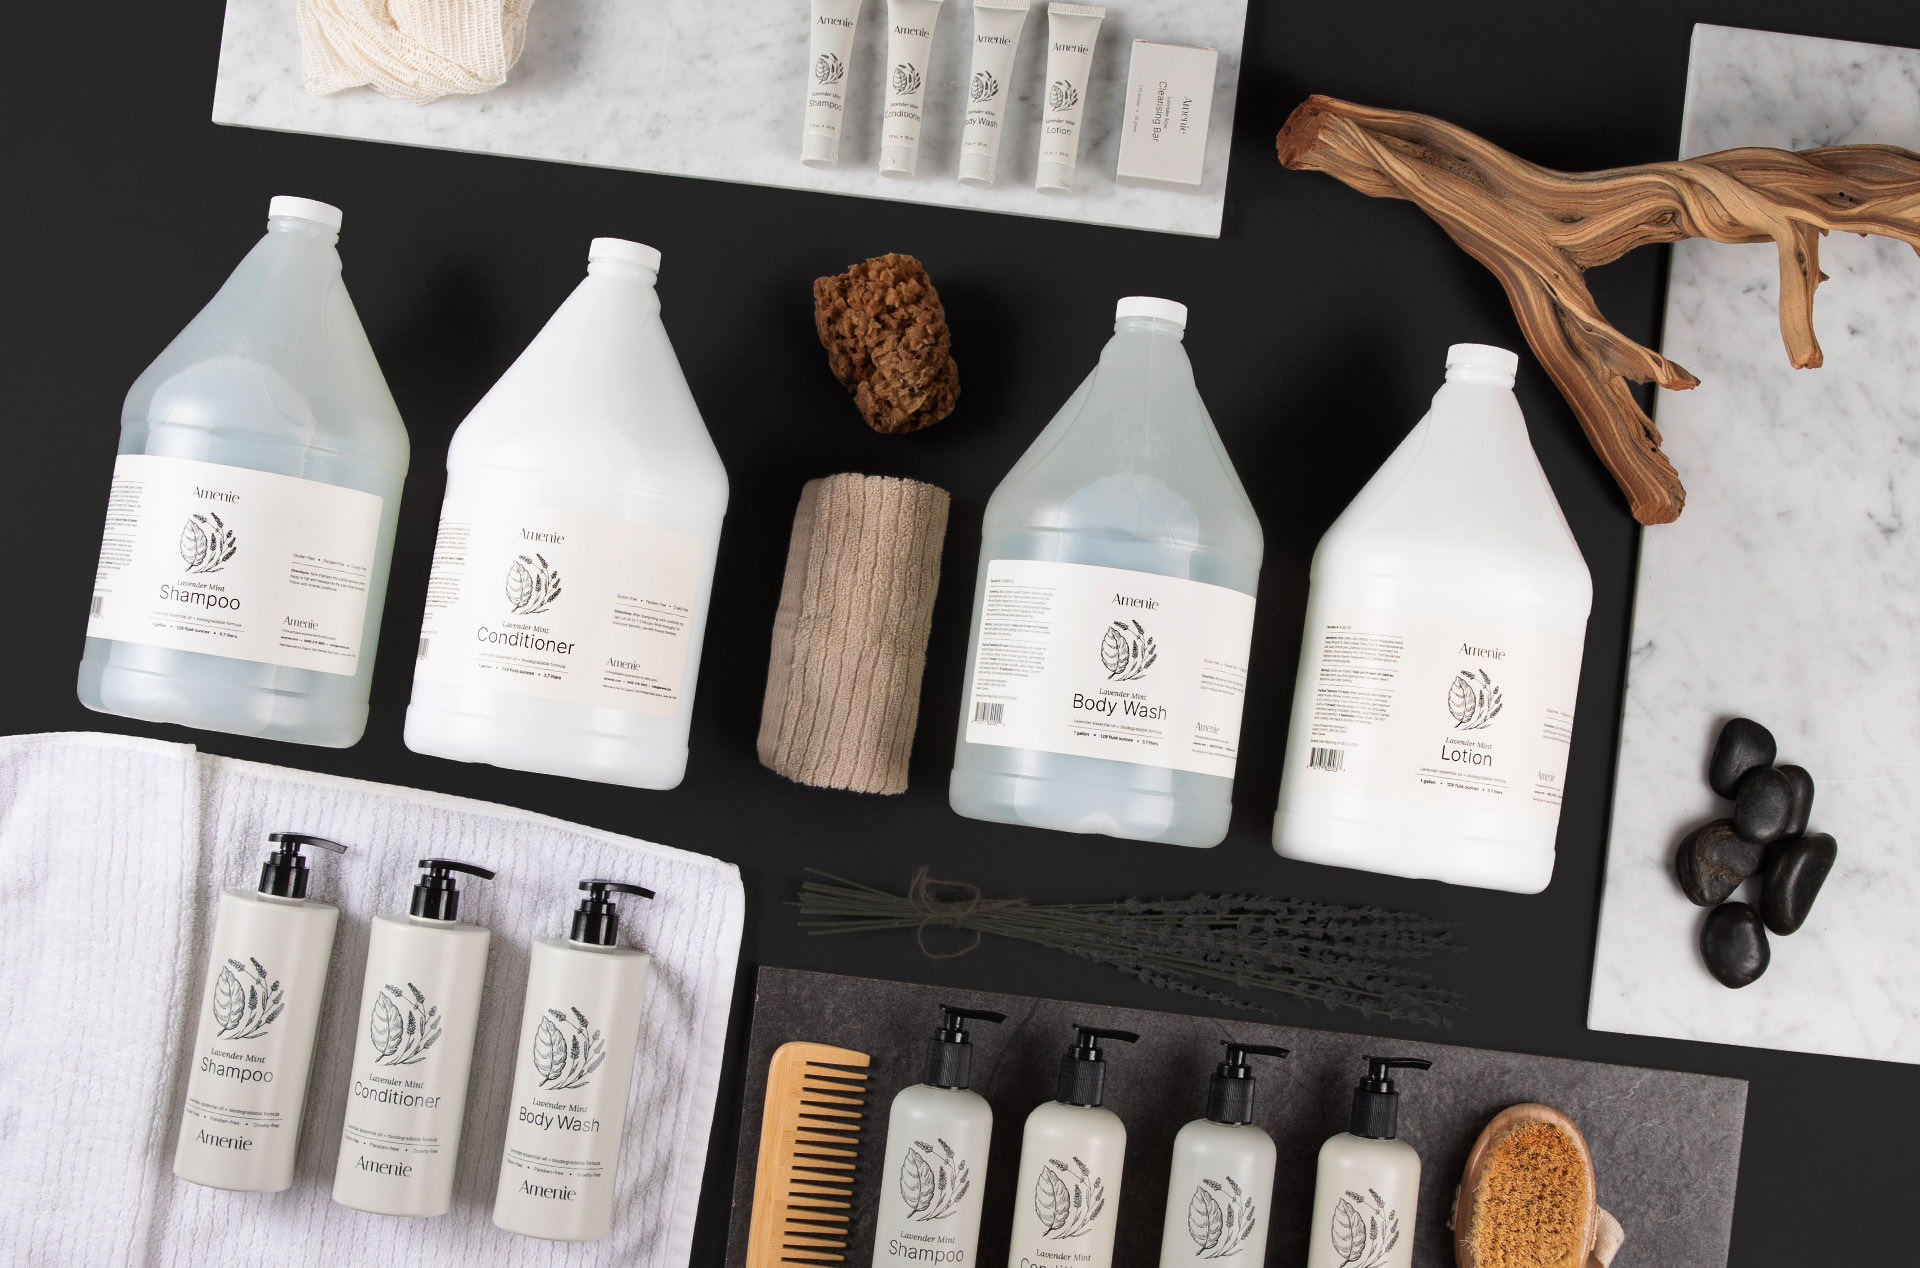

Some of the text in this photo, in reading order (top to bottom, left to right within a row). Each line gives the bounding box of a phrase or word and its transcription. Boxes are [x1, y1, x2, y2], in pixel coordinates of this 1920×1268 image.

[817, 16, 853, 28] Amenie
[894, 25, 930, 38] Amenie
[976, 34, 1011, 46] Amenie
[1052, 42, 1089, 54] Amenie
[1152, 81, 1168, 142] Cleansing Bar
[1179, 96, 1192, 135] Amenie
[978, 117, 998, 129] Wash
[1046, 126, 1072, 136] Lotion
[192, 486, 240, 504] Amenie
[519, 527, 565, 545] Amenie
[177, 578, 225, 593] Lavender Mint
[159, 584, 241, 611] Shampoo
[1111, 593, 1160, 611] Amenie
[283, 616, 319, 630] Amenie
[502, 620, 550, 634] Lavender Mint
[477, 626, 576, 655] Conditioner
[1459, 643, 1506, 661] Amenie
[607, 657, 641, 671] Amenie
[1099, 687, 1147, 701] Lavender Mint
[1072, 693, 1167, 721] Body Wash
[1445, 736, 1492, 750] Lavender Mint
[1441, 745, 1492, 767] Lotion
[210, 1047, 266, 1064] Lavender Mint
[201, 1057, 274, 1083] Shampoo
[369, 1073, 424, 1089] Lavender Mint
[355, 1081, 441, 1108] Conditioner
[533, 1097, 588, 1113] Lavender Mint
[519, 1106, 600, 1133] Body Wash
[196, 1129, 252, 1151] Amenie
[355, 1155, 412, 1177] Amenie
[519, 1179, 577, 1202] Amenie
[900, 1230, 956, 1244] Lavender Mint
[889, 1239, 964, 1266] Shampoo
[1036, 1248, 1091, 1262] Lavender Mint
